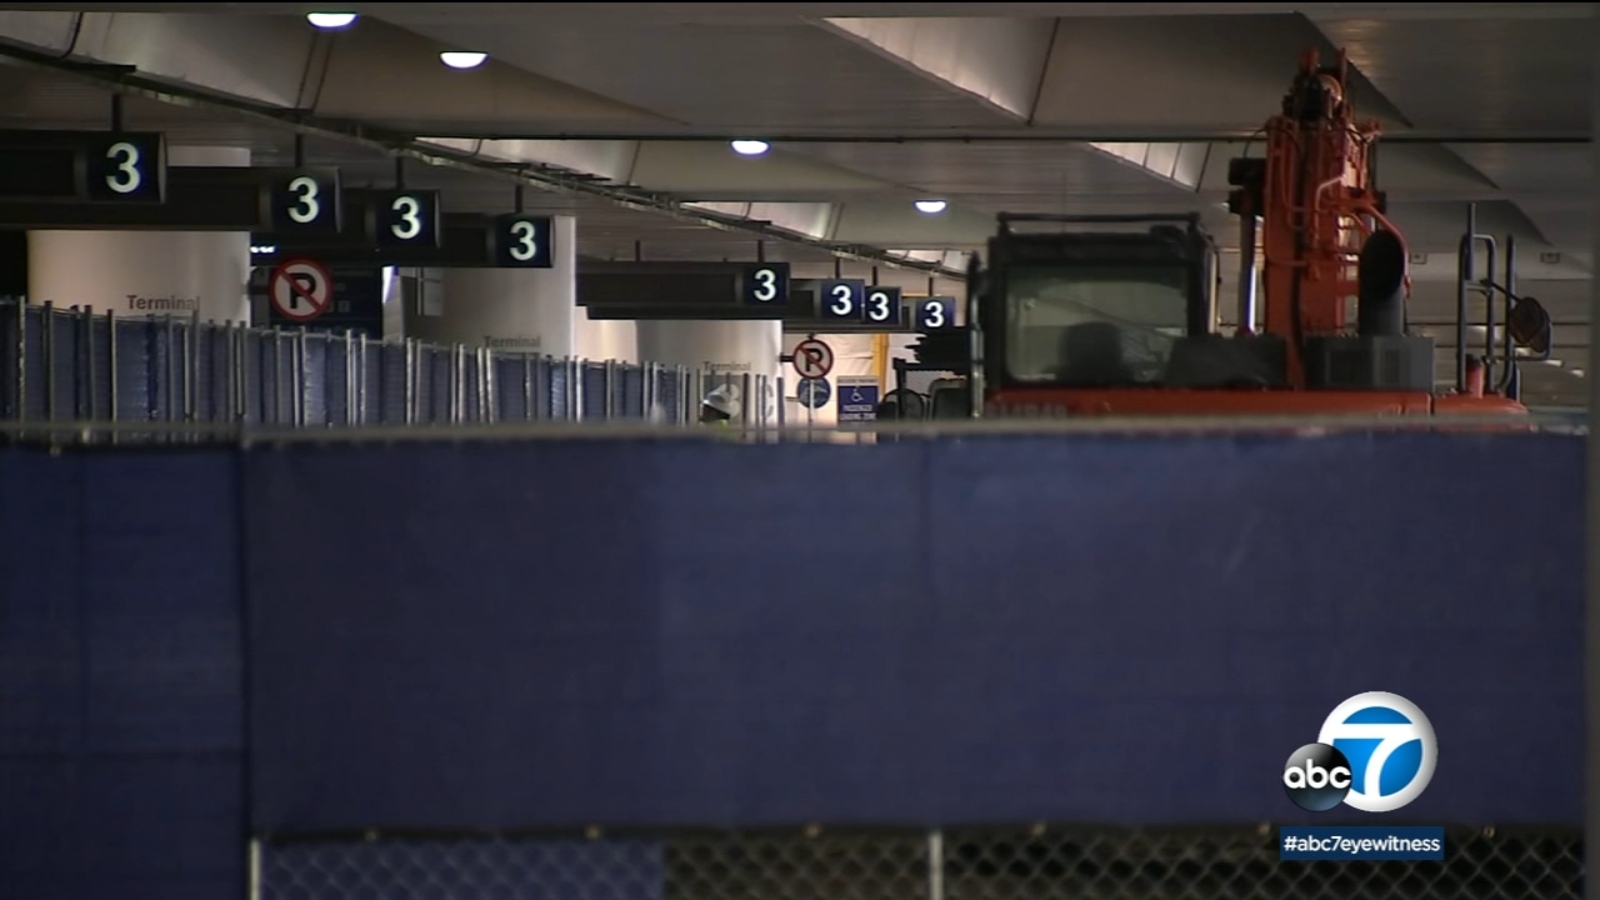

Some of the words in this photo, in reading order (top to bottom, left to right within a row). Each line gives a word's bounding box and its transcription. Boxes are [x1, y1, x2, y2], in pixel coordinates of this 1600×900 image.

[105, 142, 141, 193] 3
[287, 176, 320, 223] 3
[391, 196, 421, 239] 3
[509, 220, 537, 261] 3
[753, 269, 777, 301] 3
[830, 285, 852, 315] 3
[126, 295, 200, 310] Terminal
[869, 292, 890, 321] 3
[924, 301, 945, 328] 3
[484, 335, 541, 347] Terminal
